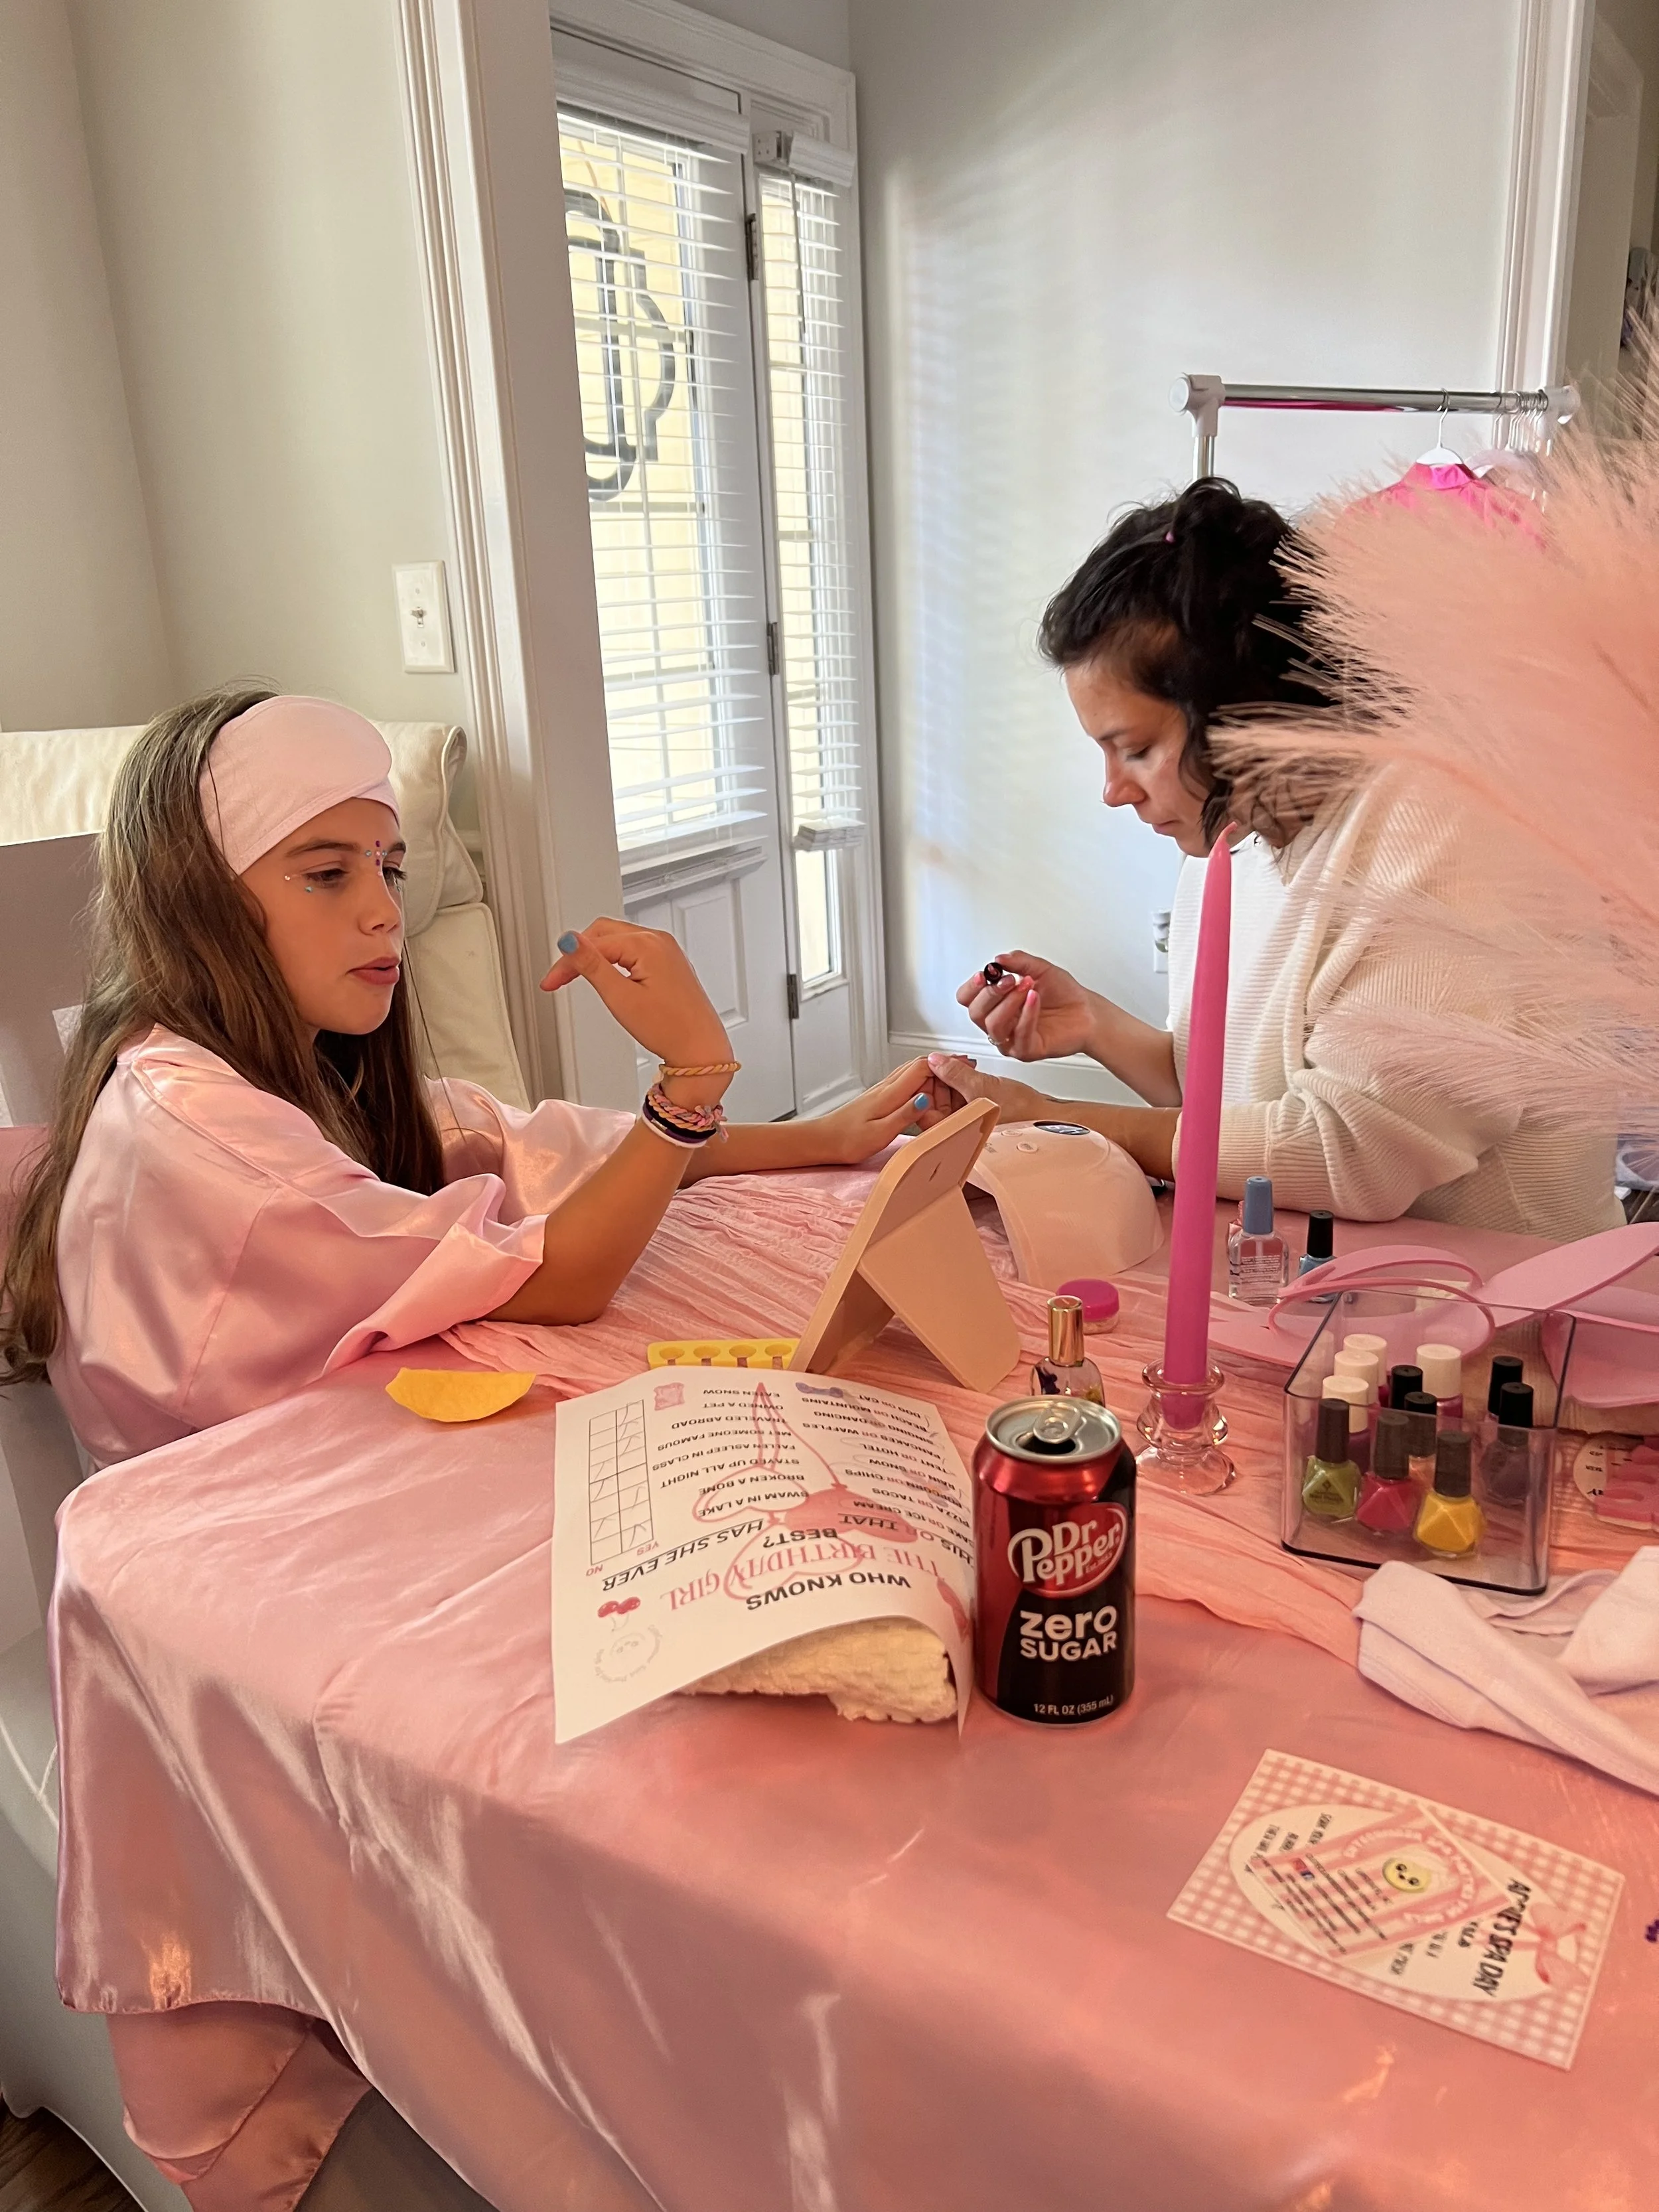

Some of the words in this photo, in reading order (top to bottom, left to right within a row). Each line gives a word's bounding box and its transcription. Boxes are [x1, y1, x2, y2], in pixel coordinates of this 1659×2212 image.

[802, 1398, 871, 1413] MOUNTAINS
[857, 1394, 879, 1404] CAT
[881, 1401, 896, 1410] OR
[814, 1411, 867, 1424] DANCING
[873, 1410, 889, 1418] OR
[898, 1406, 921, 1418] DOG
[672, 1416, 722, 1430] ABROAD
[802, 1423, 859, 1436] WAFFLES
[891, 1414, 928, 1432] BEACH
[888, 1424, 934, 1444] SINGING
[657, 1434, 705, 1451] FAMOUS
[705, 1444, 750, 1454] ASLEEP
[860, 1443, 899, 1456] HOTEL
[880, 1435, 941, 1459] PANCAKES
[652, 1455, 689, 1471] CLASS
[900, 1452, 917, 1462] OR
[701, 1463, 725, 1473] ALL
[869, 1459, 906, 1473] SNOW
[920, 1459, 946, 1473] TENT
[660, 1469, 699, 1488] NIGHT
[750, 1474, 804, 1483] BROKEN
[845, 1469, 883, 1480] CHIPS
[928, 1475, 956, 1490] RAIN
[698, 1481, 735, 1496] BONE
[871, 1487, 914, 1503] TACOS
[906, 1481, 962, 1509] POPCORN
[698, 1501, 732, 1518] LAKE
[853, 1501, 901, 1514] CREAM
[917, 1500, 934, 1509] OR
[839, 1515, 900, 1532] THAT
[904, 1511, 926, 1521] ICE
[928, 1518, 944, 1529] OR
[936, 1506, 970, 1528] PIZZA
[716, 1520, 763, 1543] HAS
[762, 1528, 837, 1548] BEST?
[1052, 1520, 1097, 1556] Dr
[636, 1540, 659, 1556] YES
[664, 1538, 709, 1565] SHE
[941, 1539, 974, 1568] HIS
[1007, 1523, 1120, 1585] Pepper
[729, 1543, 876, 1587] BIRTHDAY
[883, 1546, 938, 1577] THE
[586, 1564, 603, 1576] NO
[603, 1558, 658, 1591] EVER
[849, 1572, 911, 1589] WHO
[660, 1569, 720, 1610] GIRL
[746, 1574, 841, 1610] KNOWS
[1020, 1605, 1117, 1641] zero
[1020, 1631, 1116, 1661] SUGAR
[1034, 1704, 1045, 1714] 12
[1048, 1705, 1059, 1716] FL
[1062, 1705, 1075, 1715] OZ
[1077, 1700, 1097, 1716] (355
[1098, 1694, 1114, 1708] mL)
[1472, 1962, 1504, 1997] DAY
